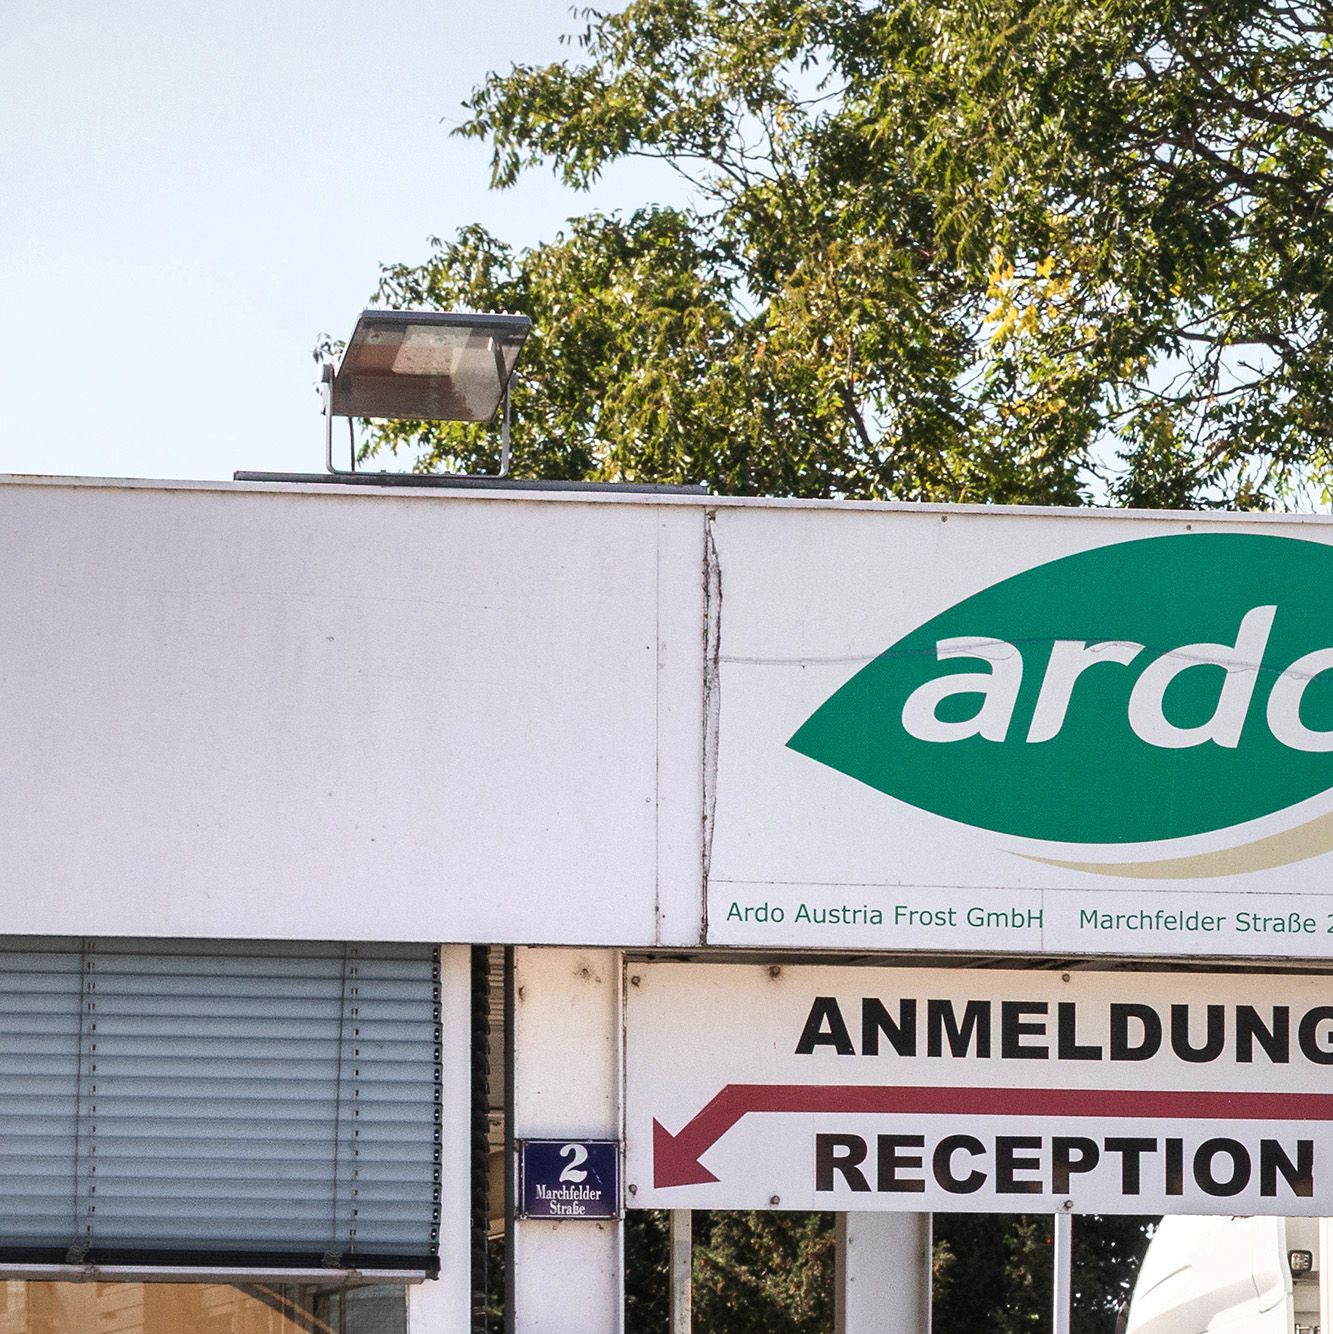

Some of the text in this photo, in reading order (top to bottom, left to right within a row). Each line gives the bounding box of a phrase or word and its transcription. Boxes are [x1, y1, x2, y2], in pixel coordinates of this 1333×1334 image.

[726, 902, 785, 923] Ardo
[794, 903, 884, 925] Austria
[894, 905, 957, 927] Frost
[966, 907, 1044, 929] GmbH
[1079, 909, 1227, 932] Marchfelder
[1235, 912, 1317, 933] Straße
[559, 1143, 588, 1183] 2
[814, 1131, 1315, 1197] RECEPTION
[536, 1184, 601, 1200] Marchfelder
[550, 1199, 586, 1215] Straße
